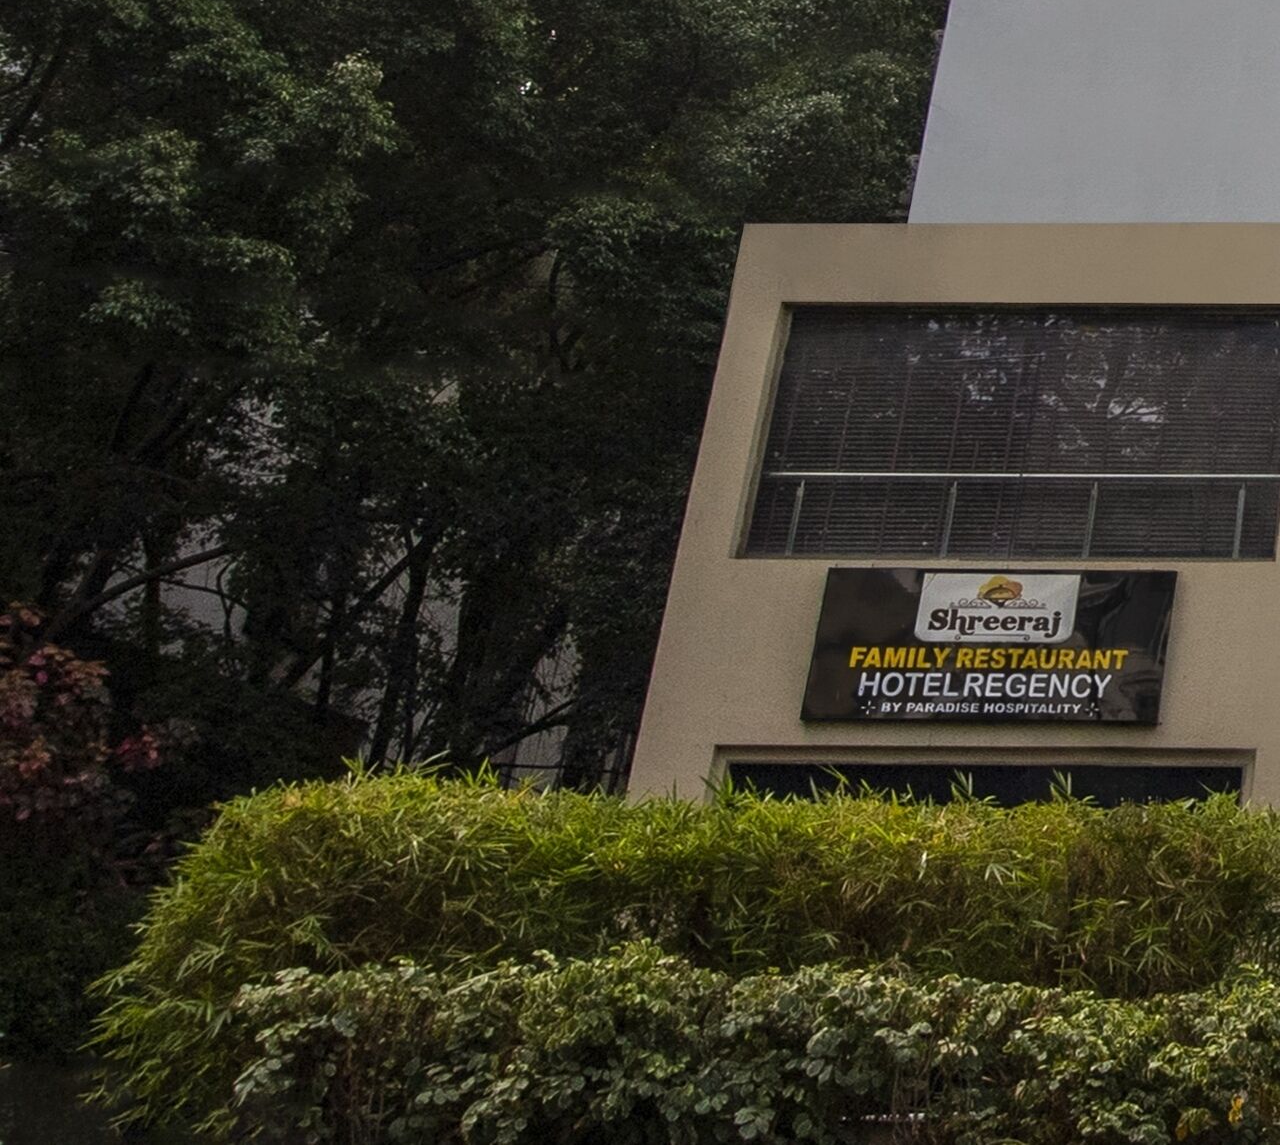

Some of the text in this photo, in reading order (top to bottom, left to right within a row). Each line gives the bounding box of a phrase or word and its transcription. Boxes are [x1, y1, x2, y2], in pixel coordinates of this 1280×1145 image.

[928, 607, 1062, 637] Shreeraj
[849, 646, 1129, 669] FAMILY RESTAURANT
[858, 671, 1112, 698] HOTEL REGENCY
[881, 702, 1081, 714] BY PARADISE HOSPITALITY
